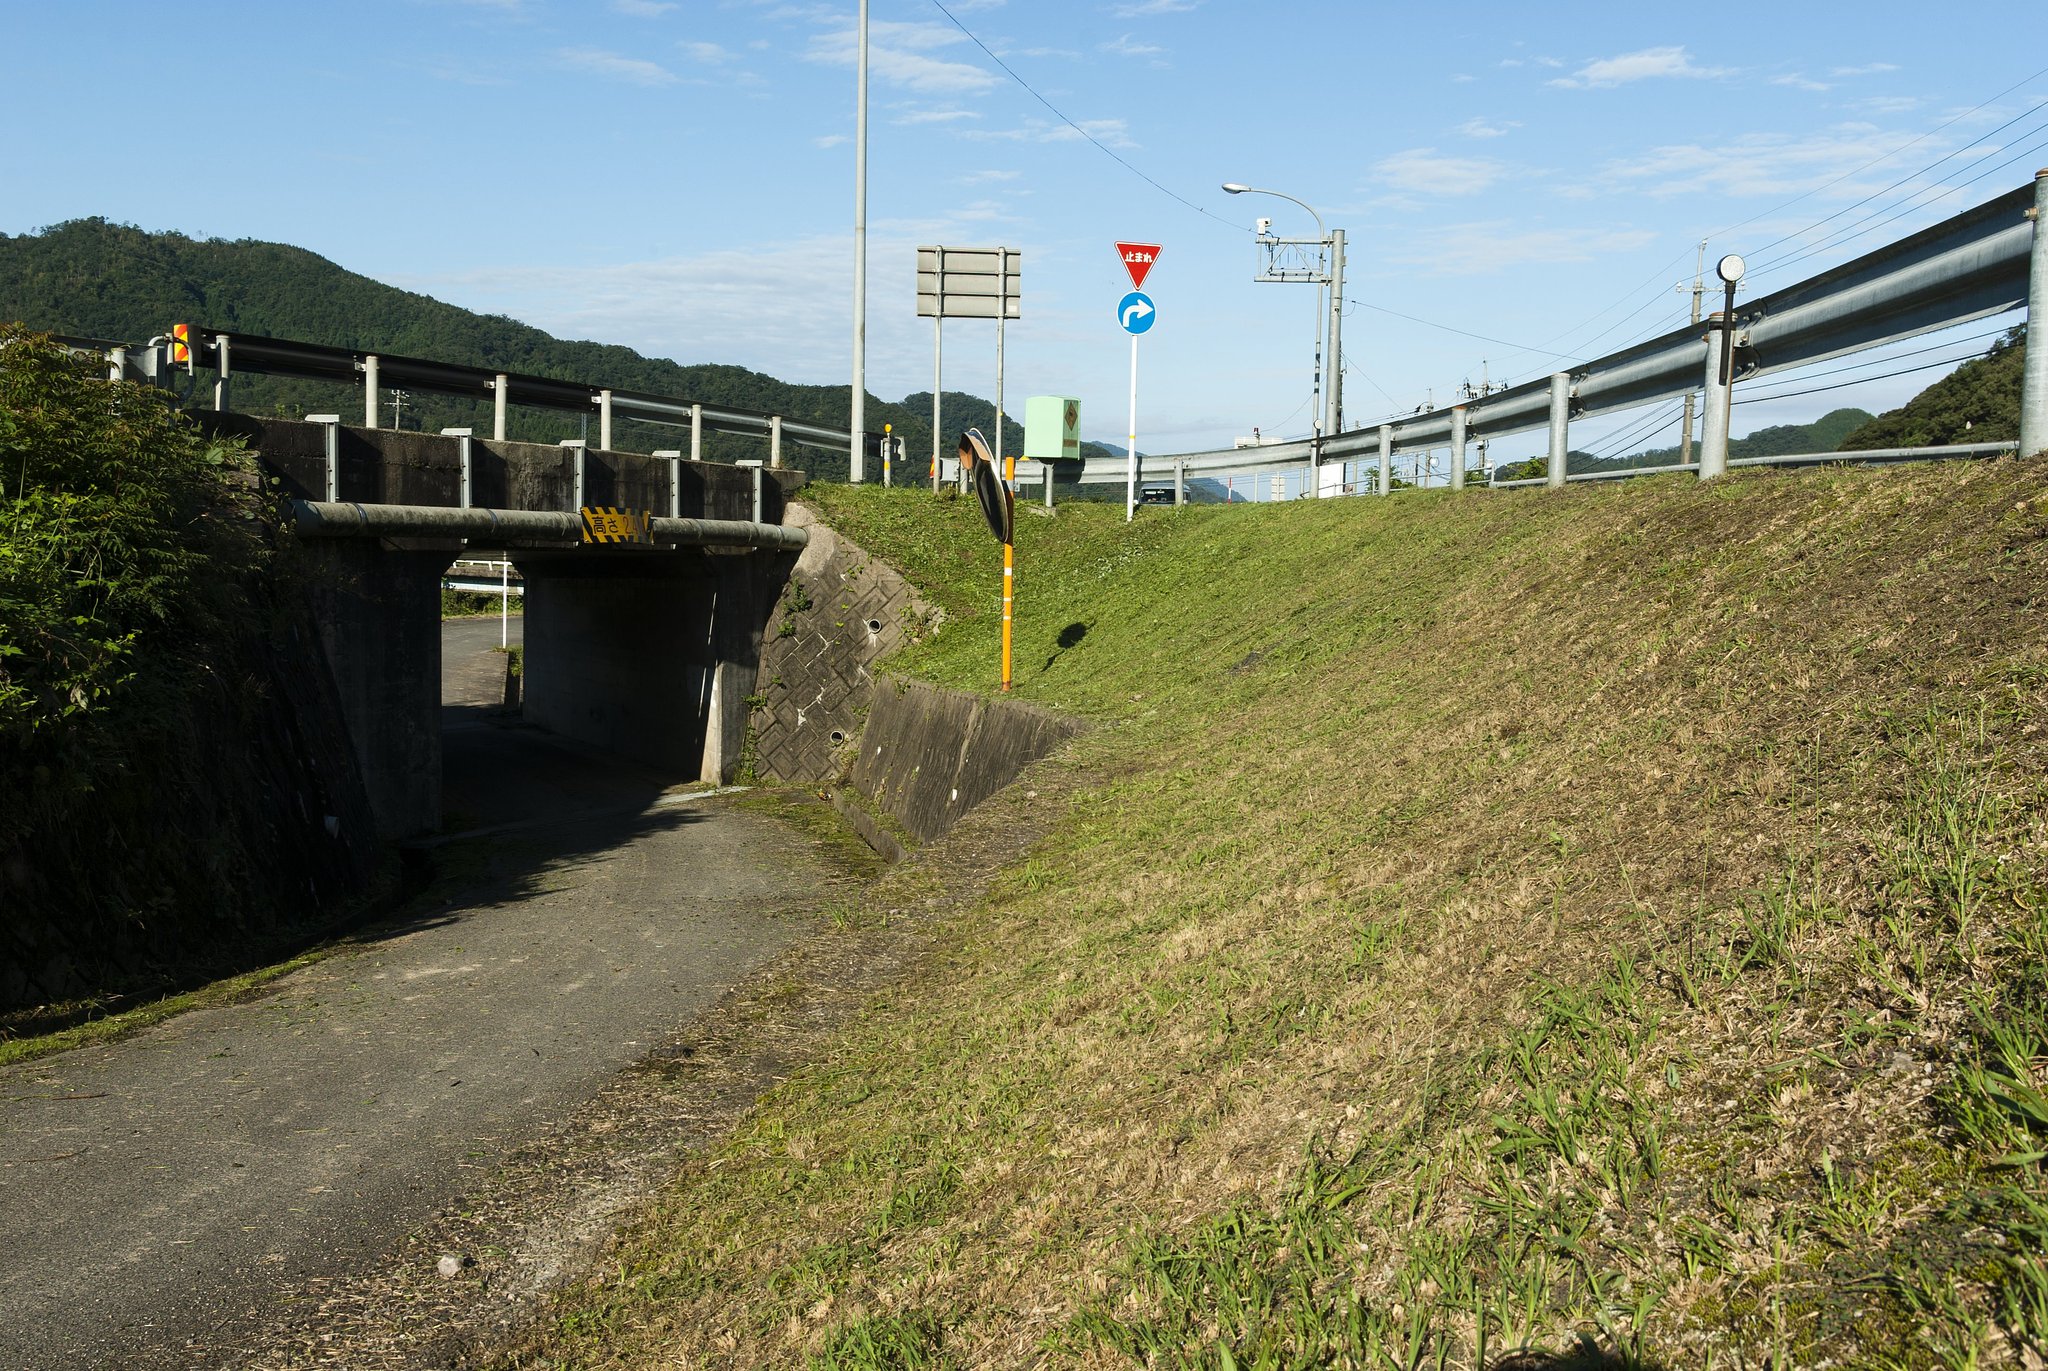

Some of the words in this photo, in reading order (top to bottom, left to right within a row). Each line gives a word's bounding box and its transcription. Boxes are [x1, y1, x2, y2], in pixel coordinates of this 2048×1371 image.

[1125, 251, 1153, 263] 止まれ
[591, 516, 619, 534] 高さ
